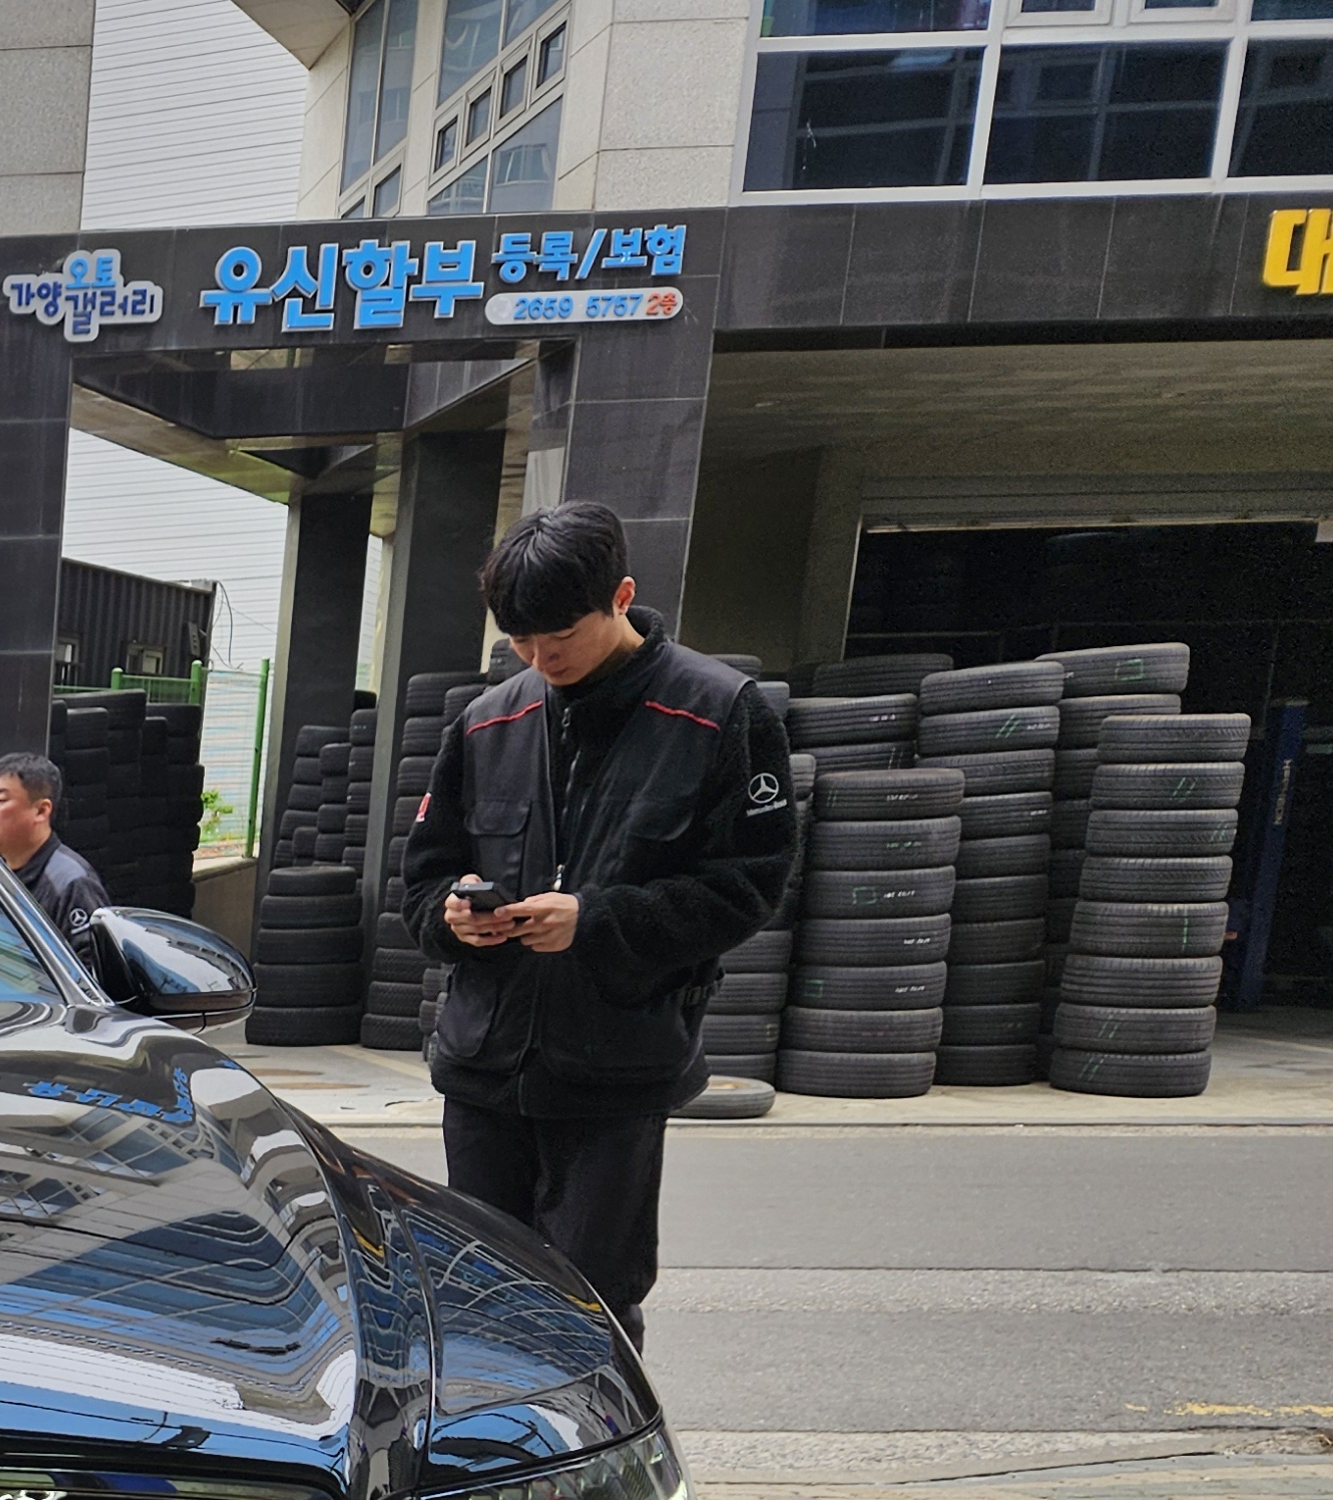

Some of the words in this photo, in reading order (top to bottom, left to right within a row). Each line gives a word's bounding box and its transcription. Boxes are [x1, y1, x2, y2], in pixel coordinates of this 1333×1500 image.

[66, 257, 116, 289] 오토
[491, 224, 687, 284] 등록/보험
[10, 281, 63, 318] 가양
[65, 289, 155, 335] 갤러리
[200, 239, 485, 332] 유신할부
[513, 296, 574, 321] 2659
[586, 293, 644, 319] 5757
[646, 292, 678, 316] 2층
